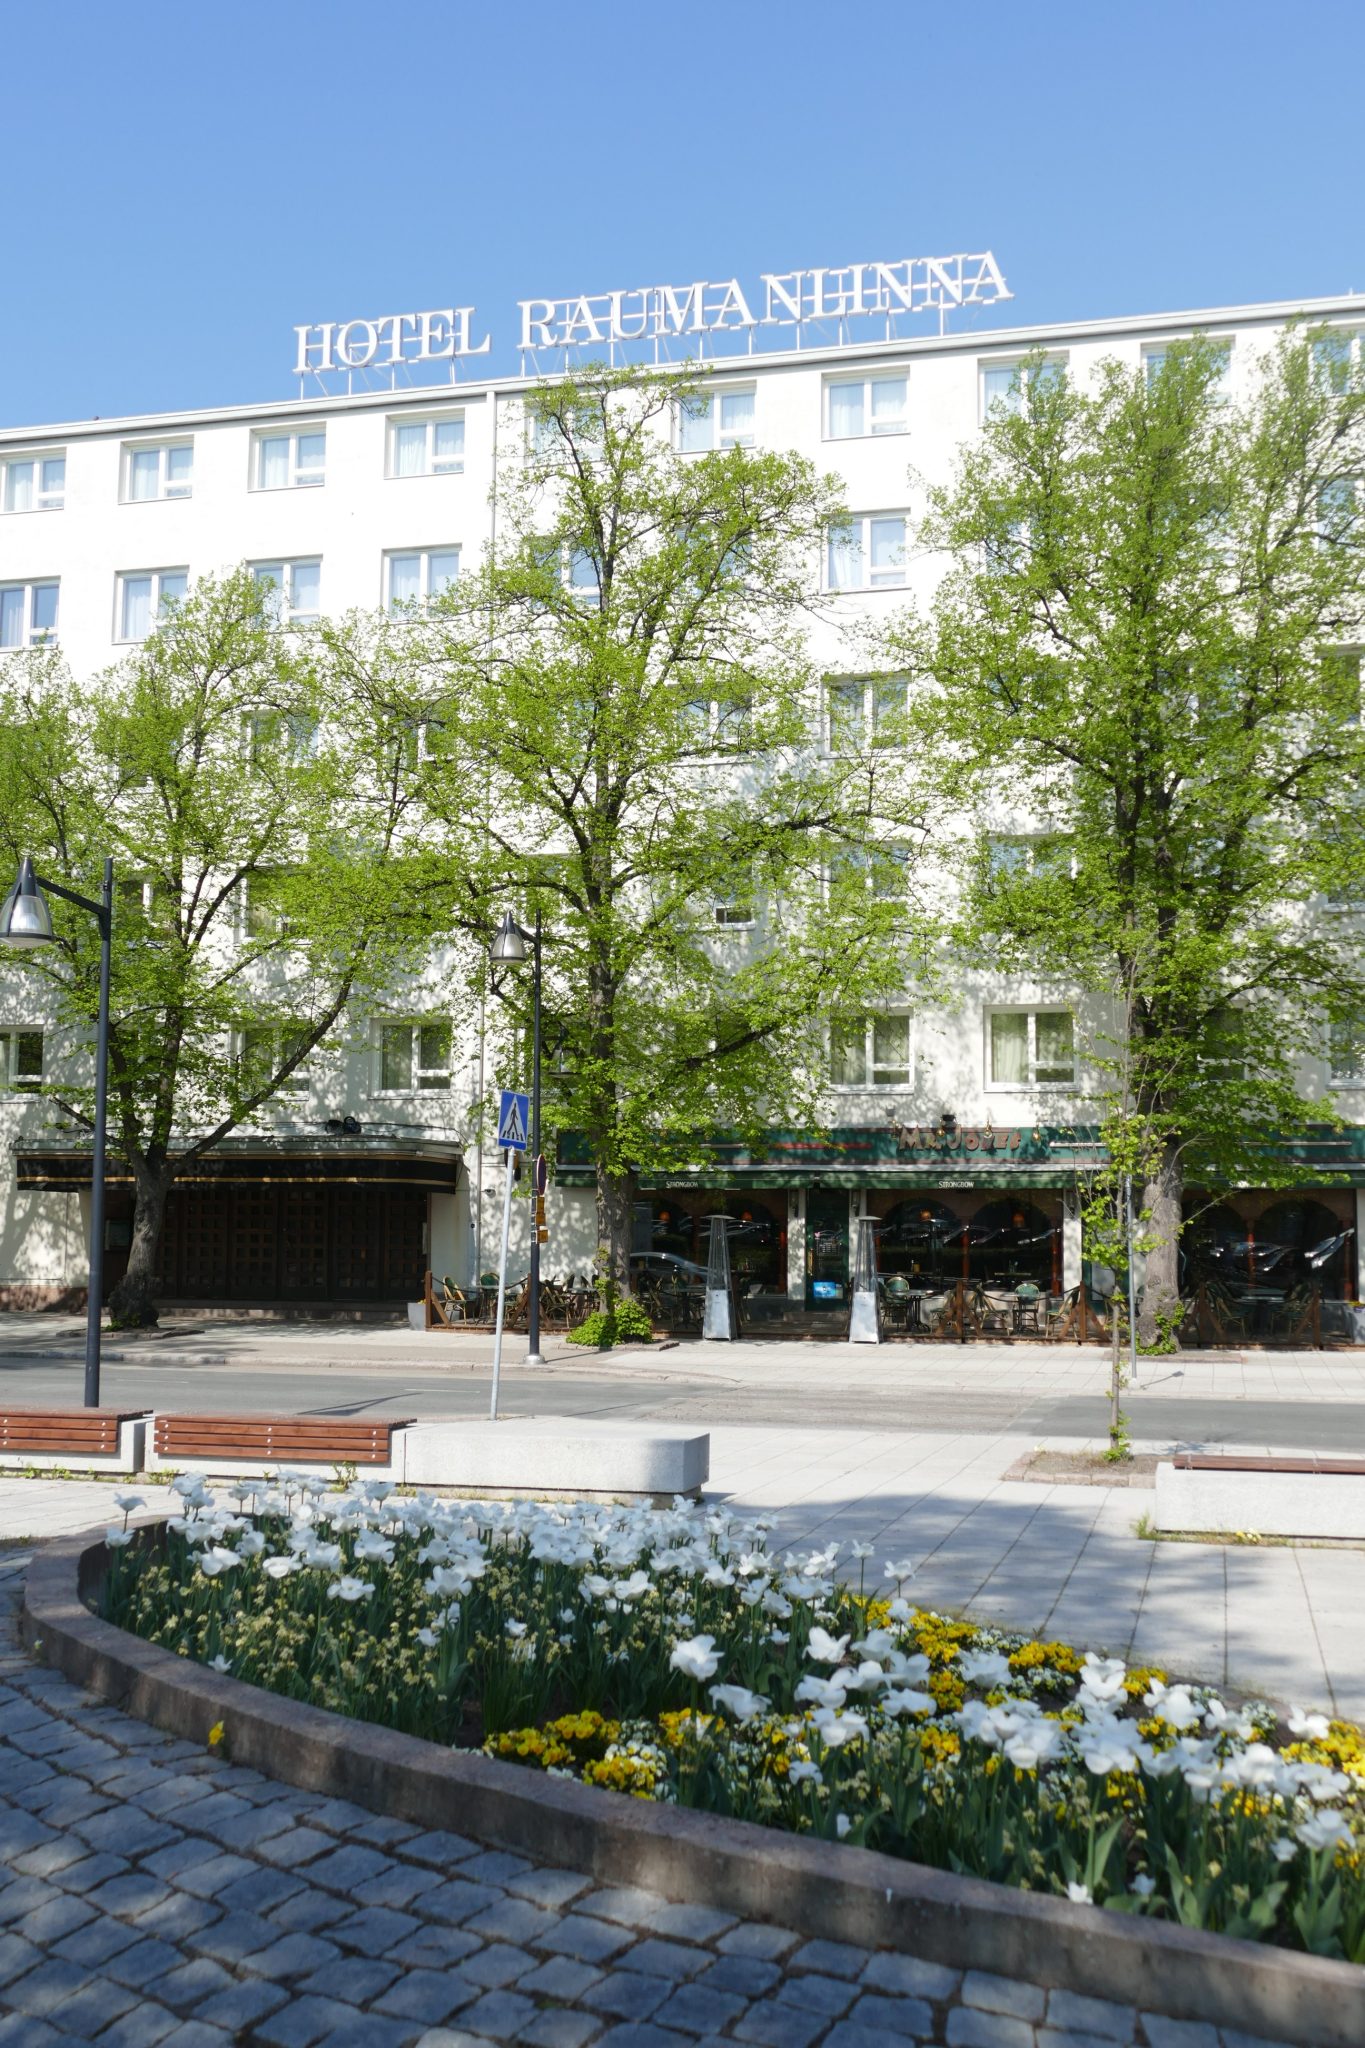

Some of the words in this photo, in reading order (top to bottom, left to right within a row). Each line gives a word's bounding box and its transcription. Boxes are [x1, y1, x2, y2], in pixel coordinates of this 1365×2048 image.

[293, 307, 491, 374] HOTEL
[516, 251, 1014, 349] RAUMANLINNA
[938, 1181, 975, 1189] STRONGBOW
